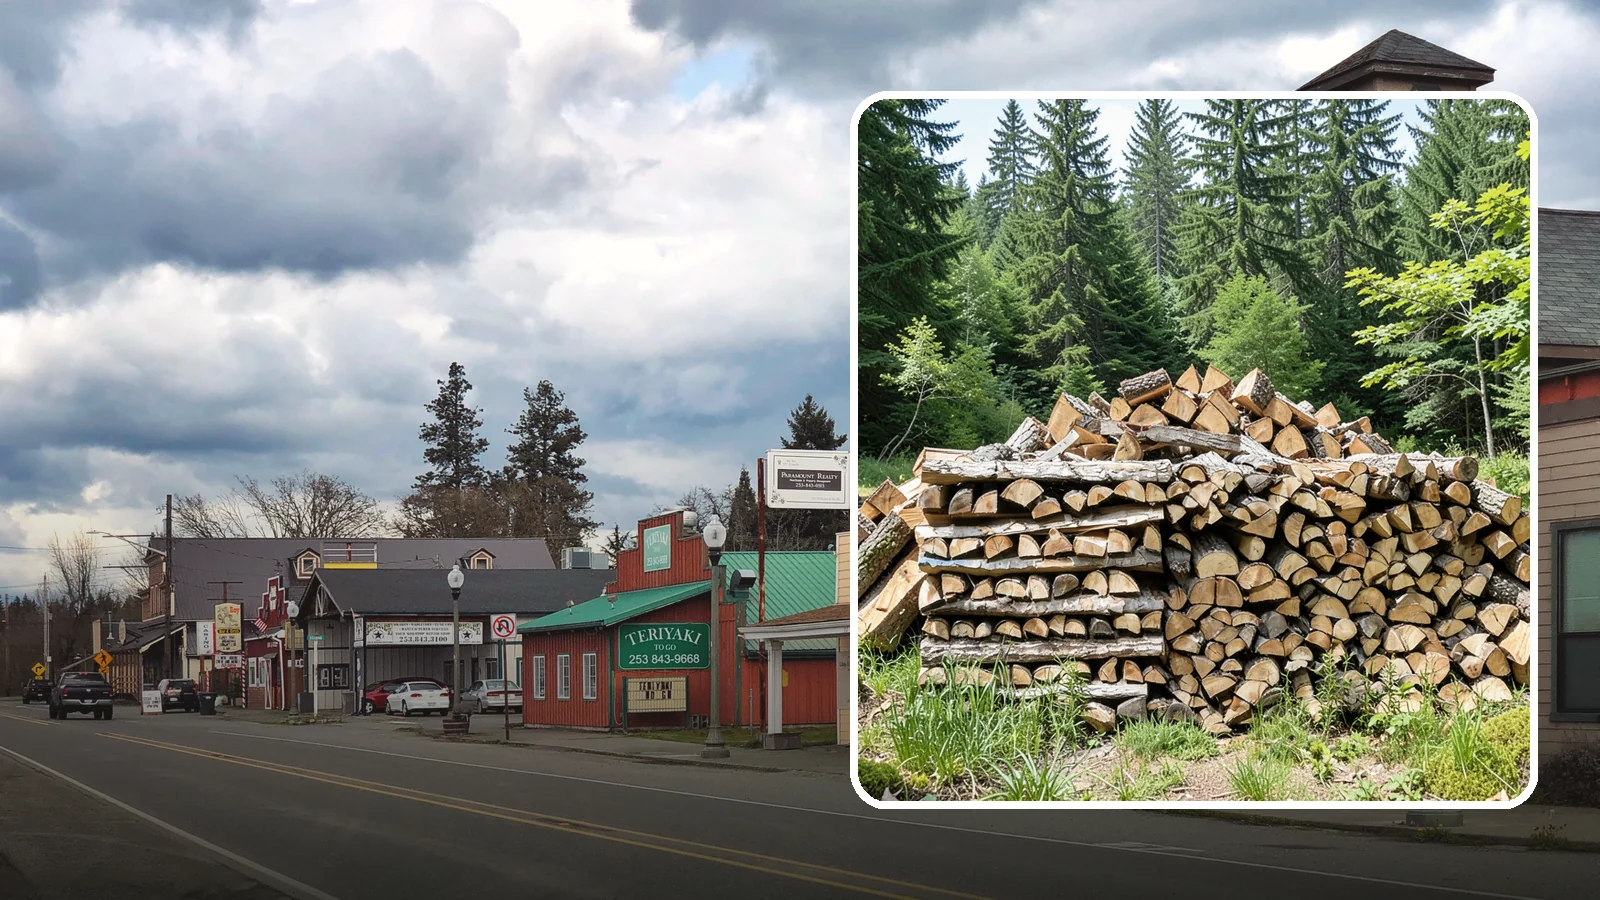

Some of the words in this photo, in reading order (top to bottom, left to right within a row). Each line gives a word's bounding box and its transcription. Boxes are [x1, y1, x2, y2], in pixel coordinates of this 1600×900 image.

[625, 627, 702, 646] TERIYAKI
[628, 654, 649, 665] 253
[651, 653, 700, 664] 843-9668
[639, 681, 673, 690] TERIYAKI
